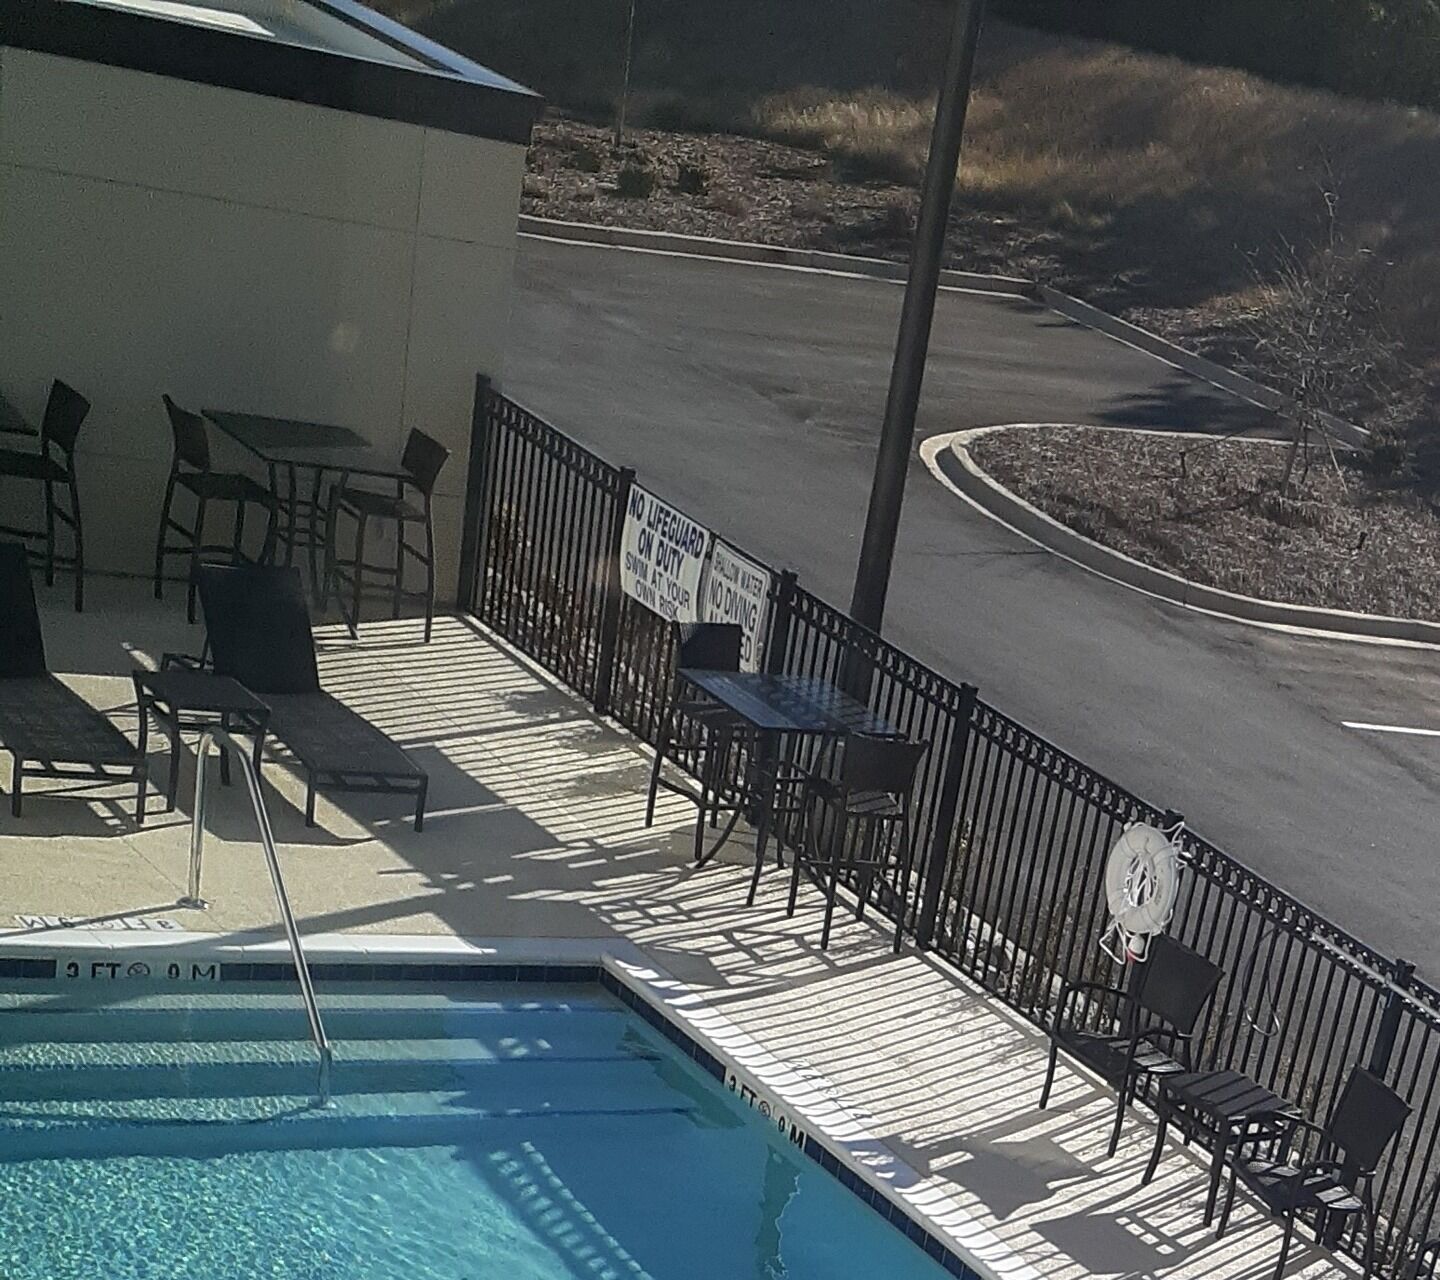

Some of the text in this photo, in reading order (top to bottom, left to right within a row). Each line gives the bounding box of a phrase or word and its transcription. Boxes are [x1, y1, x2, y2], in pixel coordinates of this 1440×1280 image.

[629, 487, 705, 559] NO LIFEGUARD
[625, 551, 690, 611] SWIM AT YOUR
[638, 528, 684, 580] ON DUTY
[714, 551, 763, 600] SHALLOW WATER
[635, 579, 679, 621] OWN RISK
[708, 576, 757, 632] NO DIVING
[91, 962, 121, 979] FT
[192, 964, 215, 980] M
[740, 1084, 757, 1107] FT
[790, 1123, 804, 1148] M
